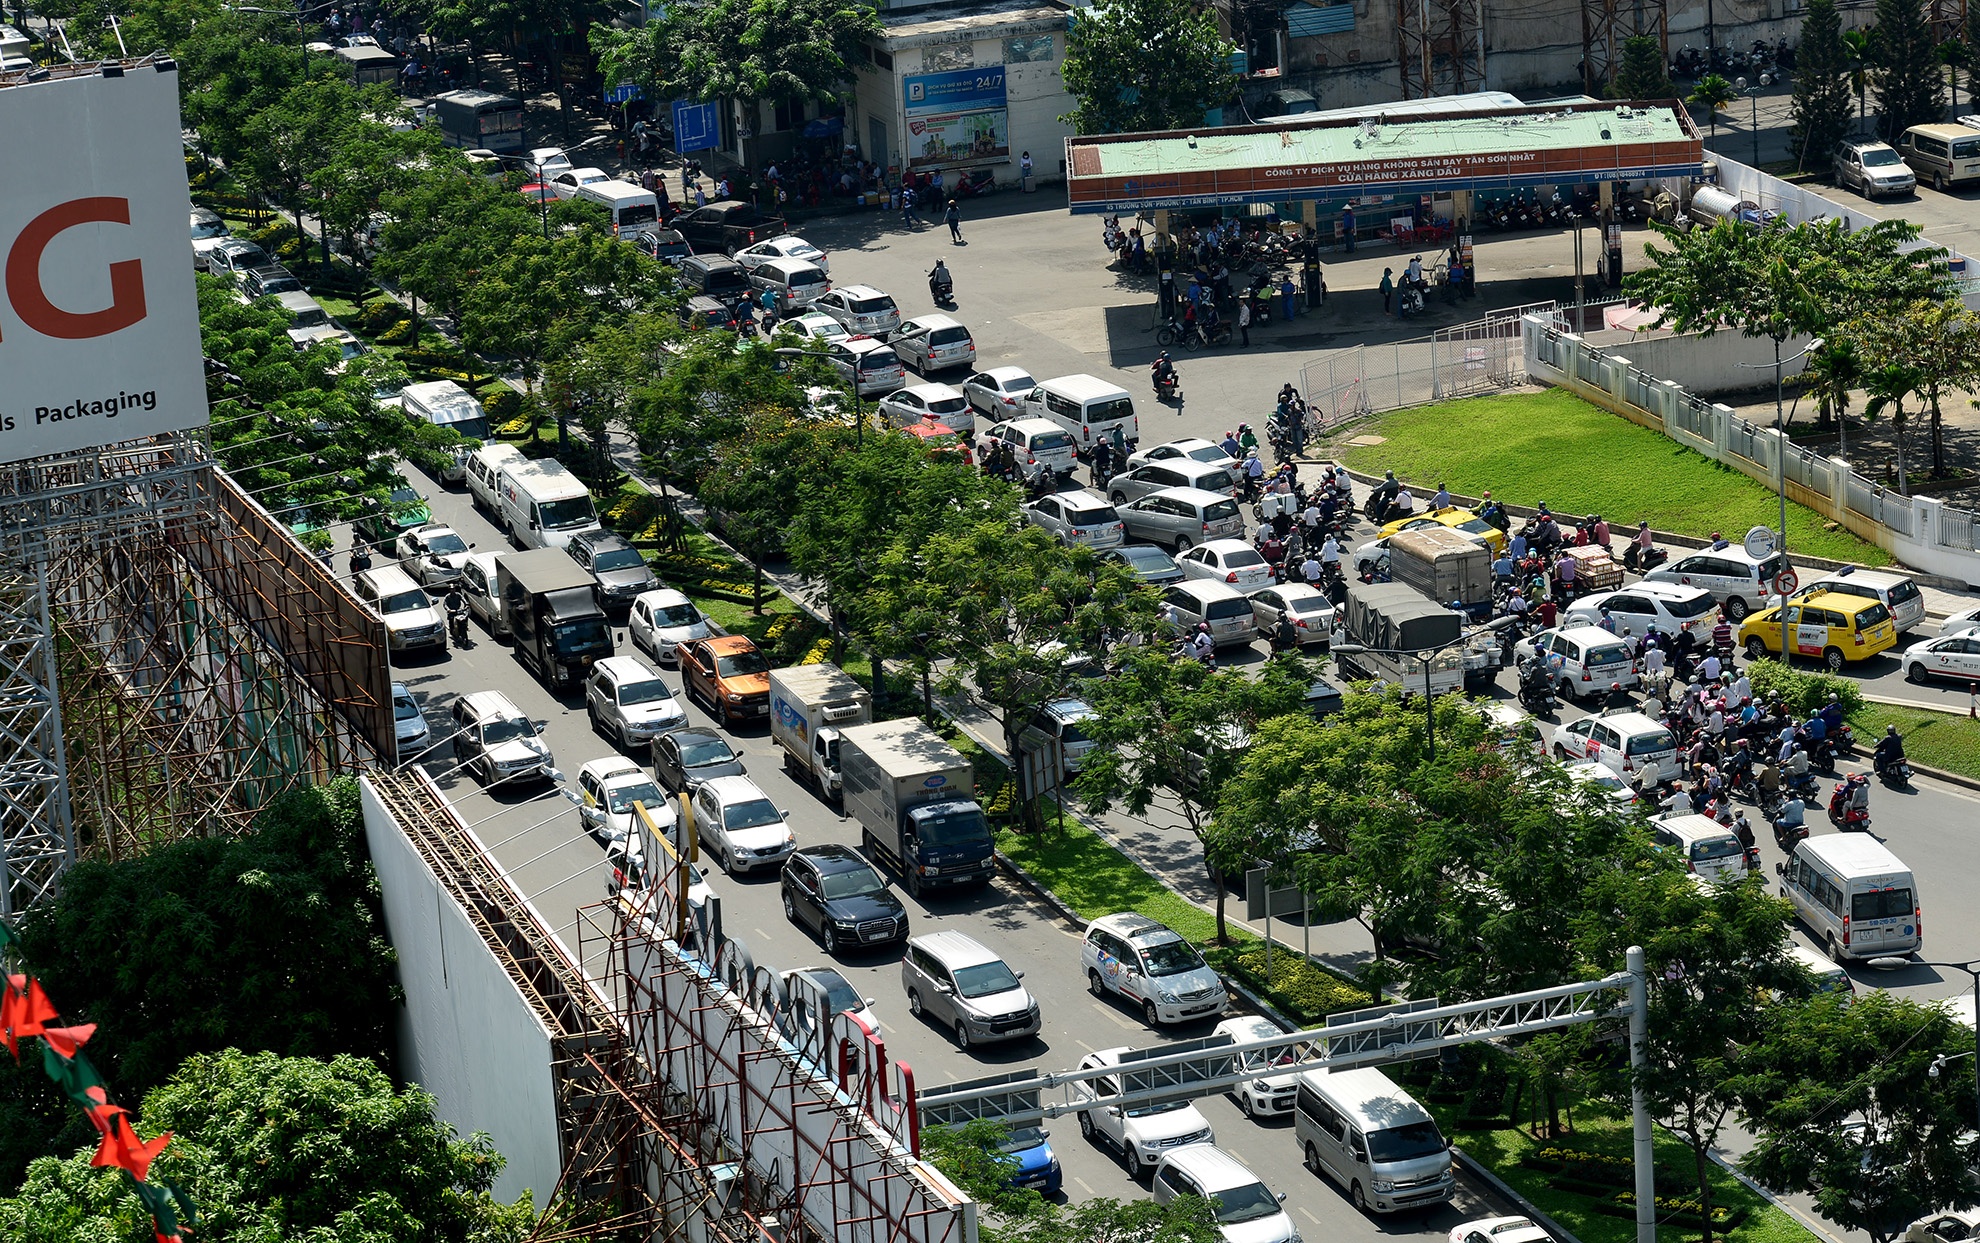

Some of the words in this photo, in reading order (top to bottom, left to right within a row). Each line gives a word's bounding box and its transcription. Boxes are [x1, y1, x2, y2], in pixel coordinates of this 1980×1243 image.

[976, 75, 1003, 88] 24/7
[913, 85, 920, 95] P
[1265, 168, 1293, 176] CÔNG
[1311, 166, 1335, 175] DỊCH
[1337, 165, 1351, 174] VỤ
[1383, 159, 1418, 169] KHÔNG
[1443, 157, 1462, 166] BAY
[1465, 156, 1485, 164] TÂN
[1487, 155, 1507, 163] SƠN
[1509, 152, 1536, 162] NHẤT
[1338, 172, 1362, 182] CỬA
[1364, 170, 1398, 181] HÀNG
[1401, 167, 1434, 179] XĂNG
[1106, 203, 1114, 211] 45
[0, 196, 147, 343] G
[35, 390, 157, 425] Packaging
